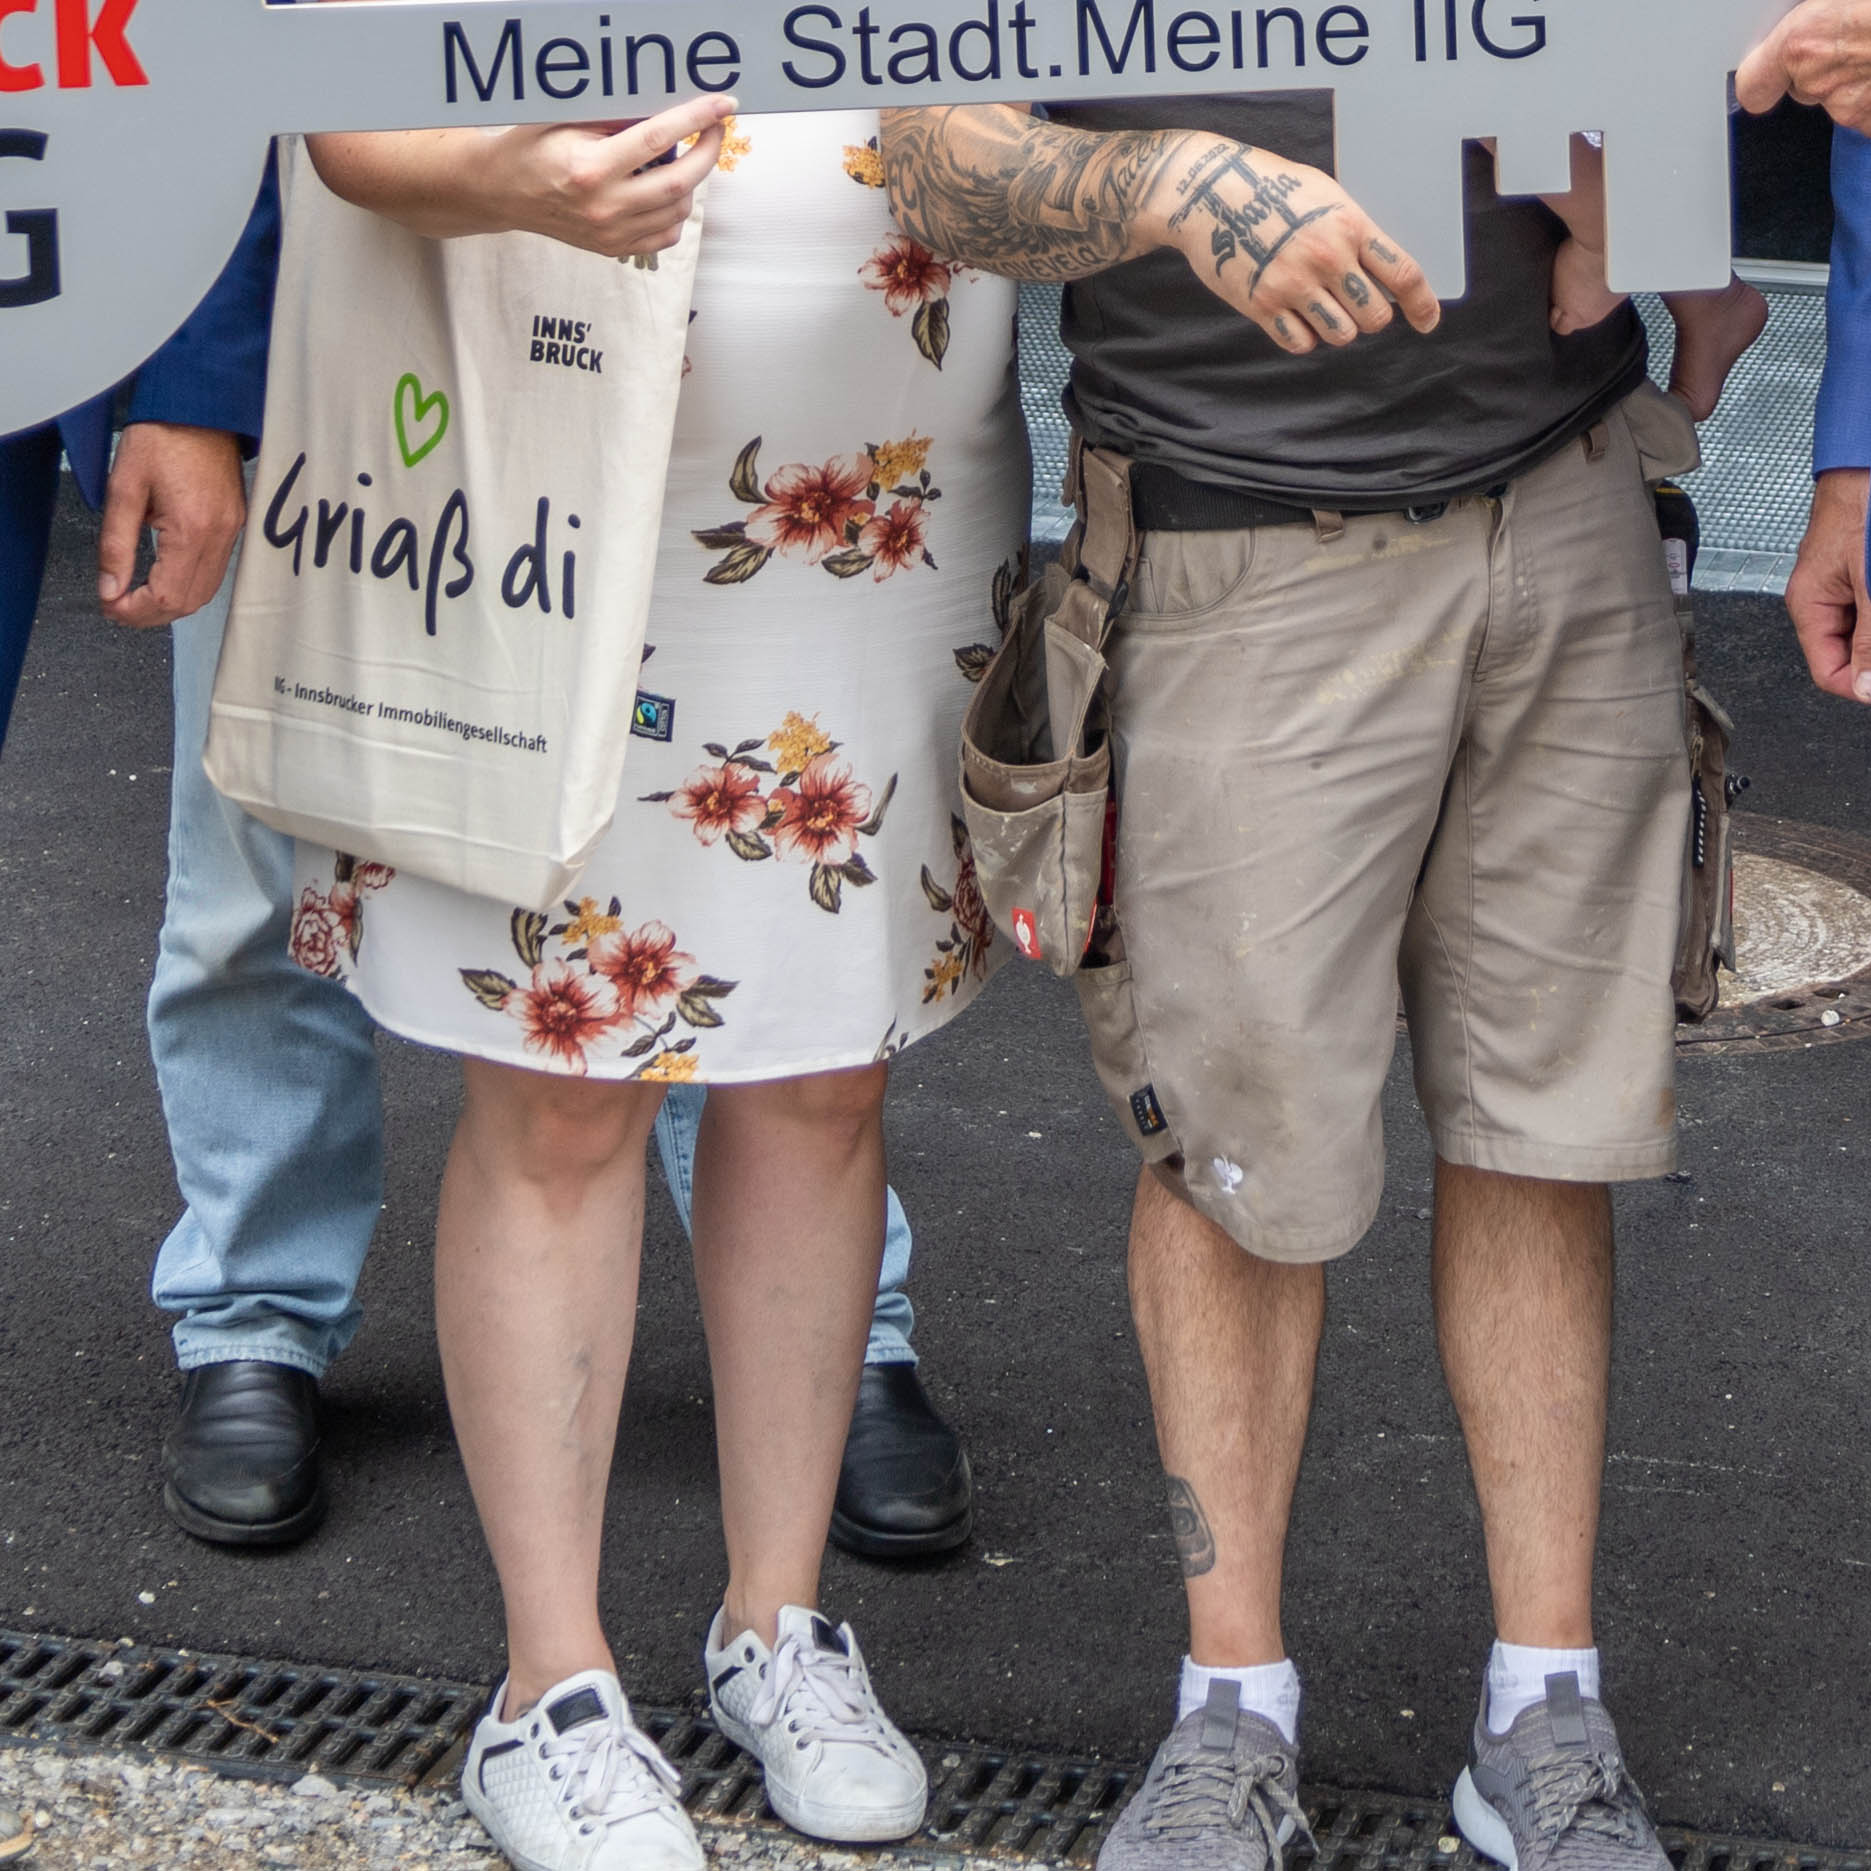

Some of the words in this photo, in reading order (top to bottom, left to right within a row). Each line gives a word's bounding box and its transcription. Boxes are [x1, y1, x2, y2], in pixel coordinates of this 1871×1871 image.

[441, 14, 742, 104] Meine
[529, 339, 603, 374] BRUCK
[532, 314, 592, 344] INNS'
[261, 451, 476, 636] Griaß
[501, 496, 583, 620] di
[294, 683, 375, 716] Innsbrucker
[377, 702, 549, 754] Immobiliengesellschaft
